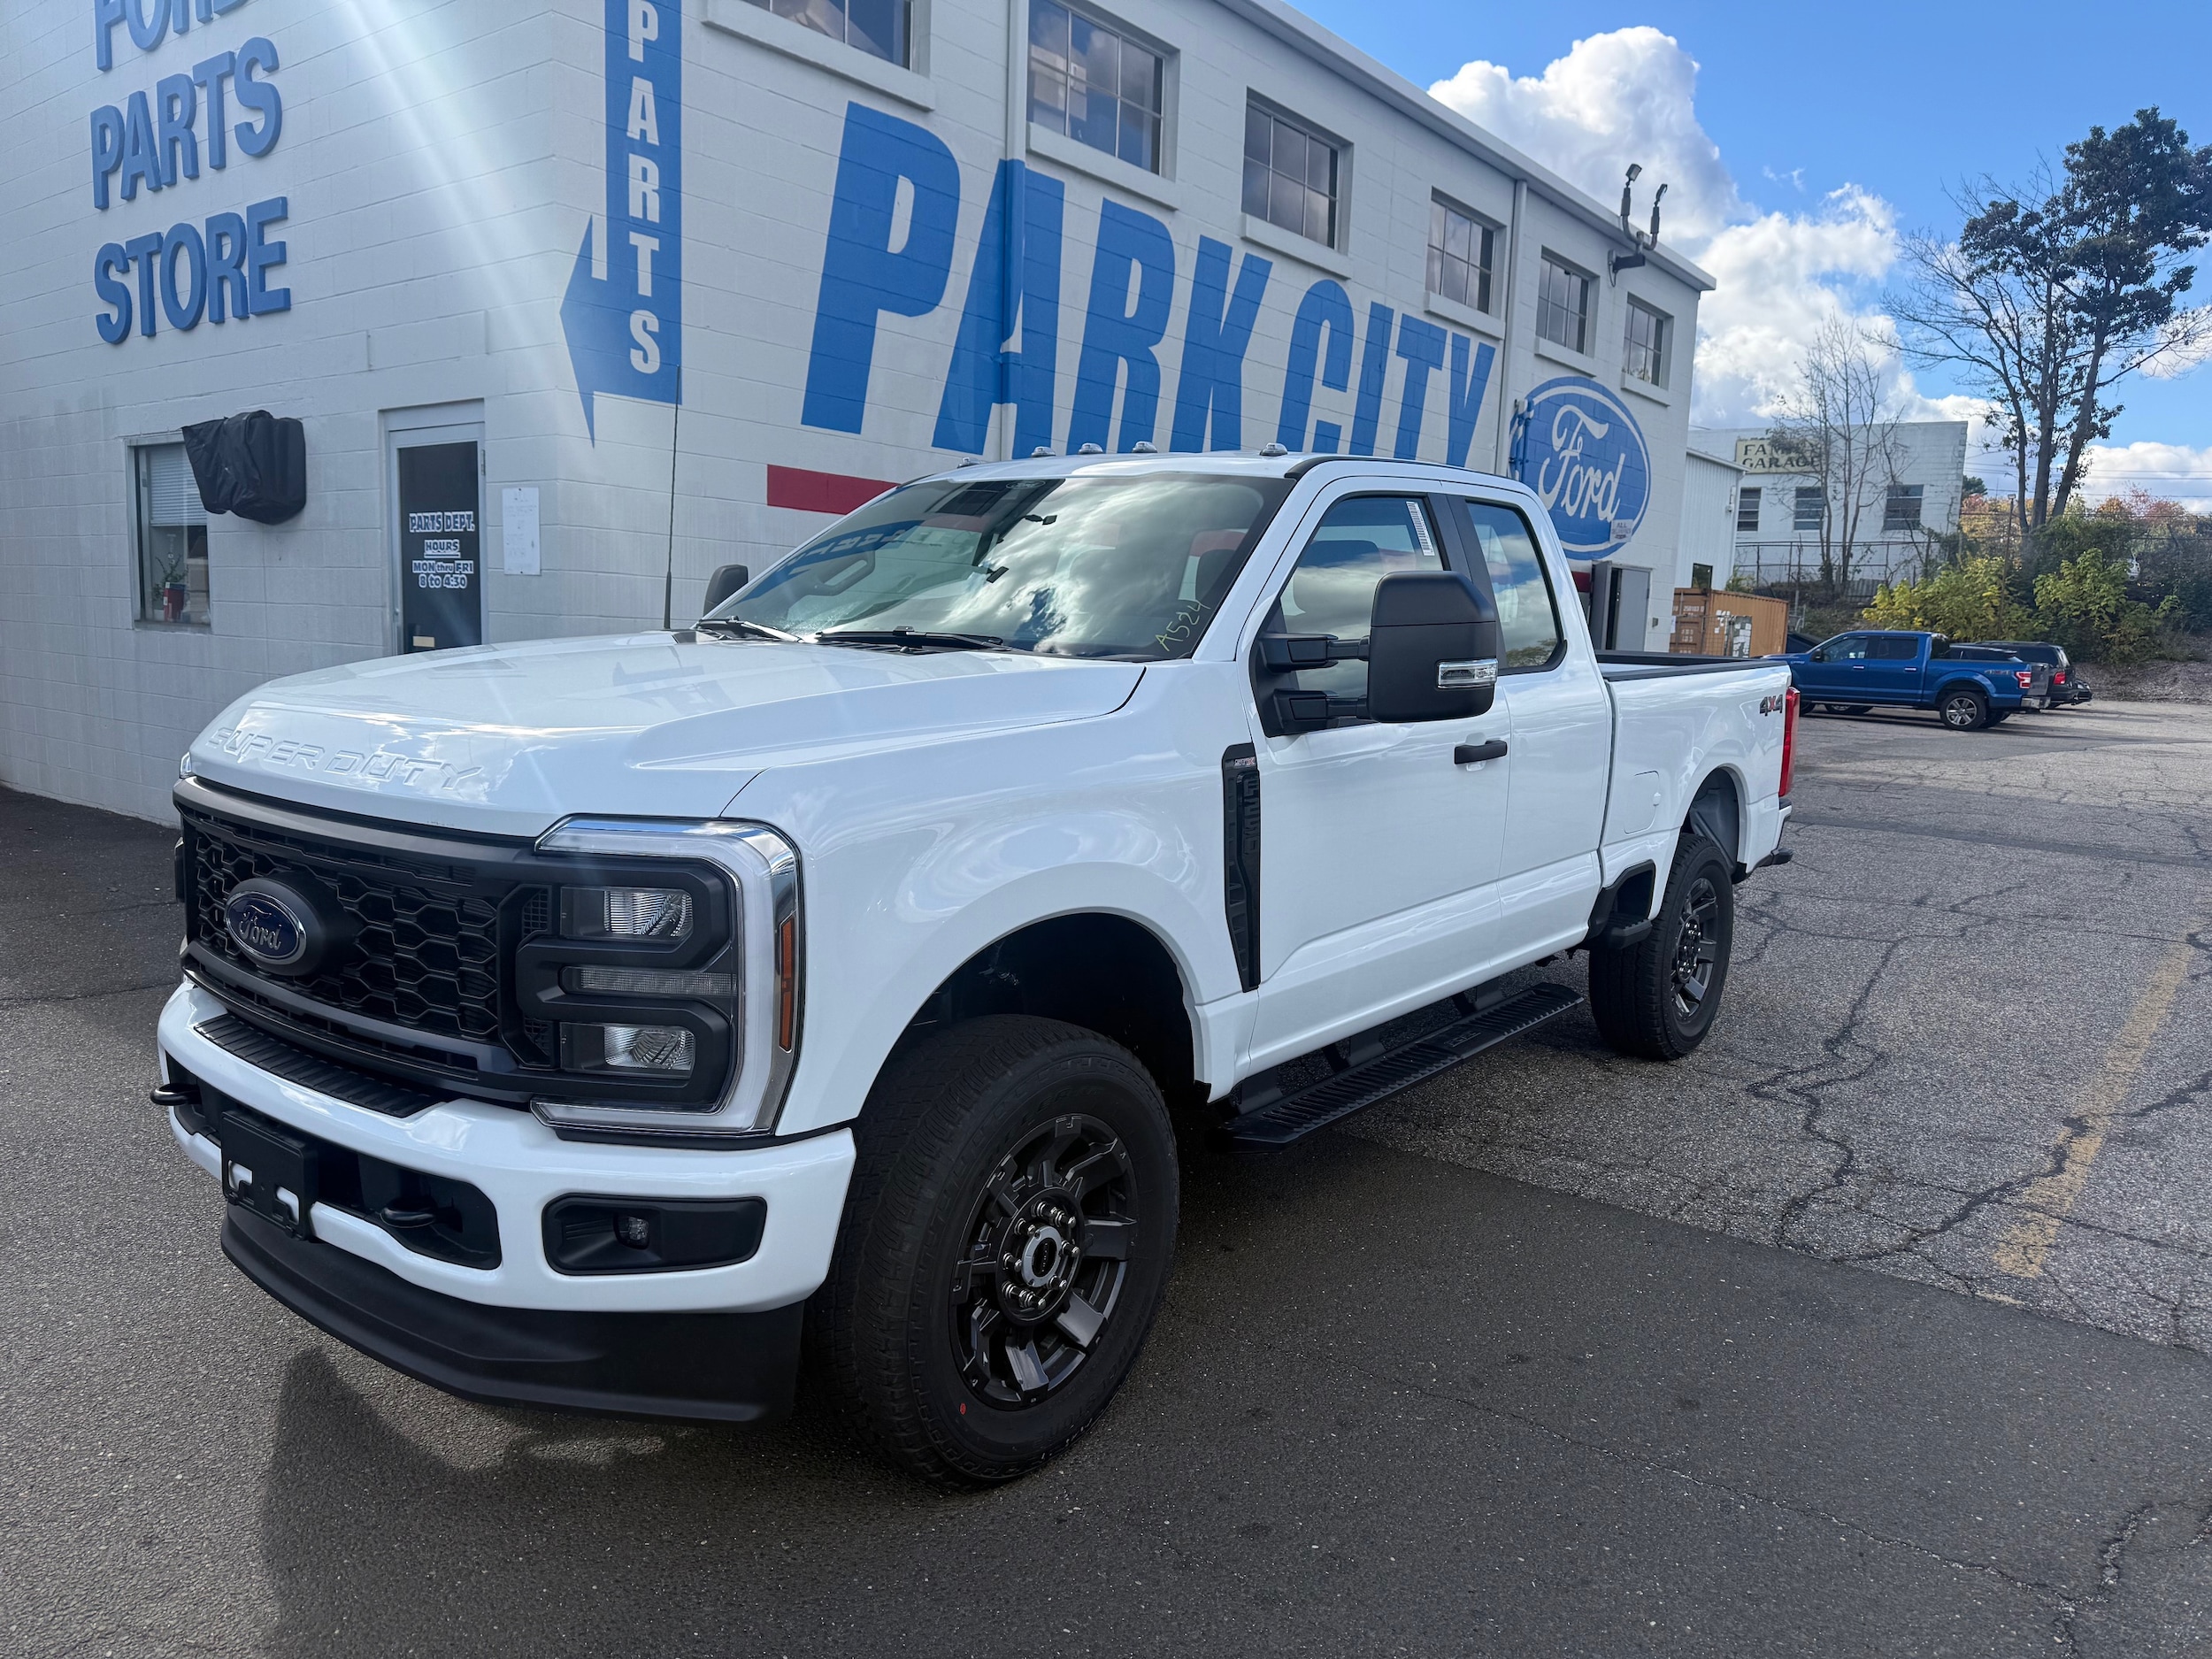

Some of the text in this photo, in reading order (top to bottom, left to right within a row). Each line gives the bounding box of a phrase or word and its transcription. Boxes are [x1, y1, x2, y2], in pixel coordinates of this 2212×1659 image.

[90, 36, 282, 210] PARTS
[626, 0, 660, 374] PARTS
[94, 196, 292, 344] STORE
[801, 101, 1495, 468] PARK CITY
[1538, 404, 1626, 522] Ford
[409, 511, 475, 533] PARTS DEPT.
[424, 540, 460, 553] HOURS
[412, 560, 474, 574] MON thru FRI
[419, 574, 468, 588] 8 to 4:30
[1155, 600, 1211, 652] A524
[205, 726, 484, 791] SUPER DUTY
[238, 904, 283, 951] Ford
